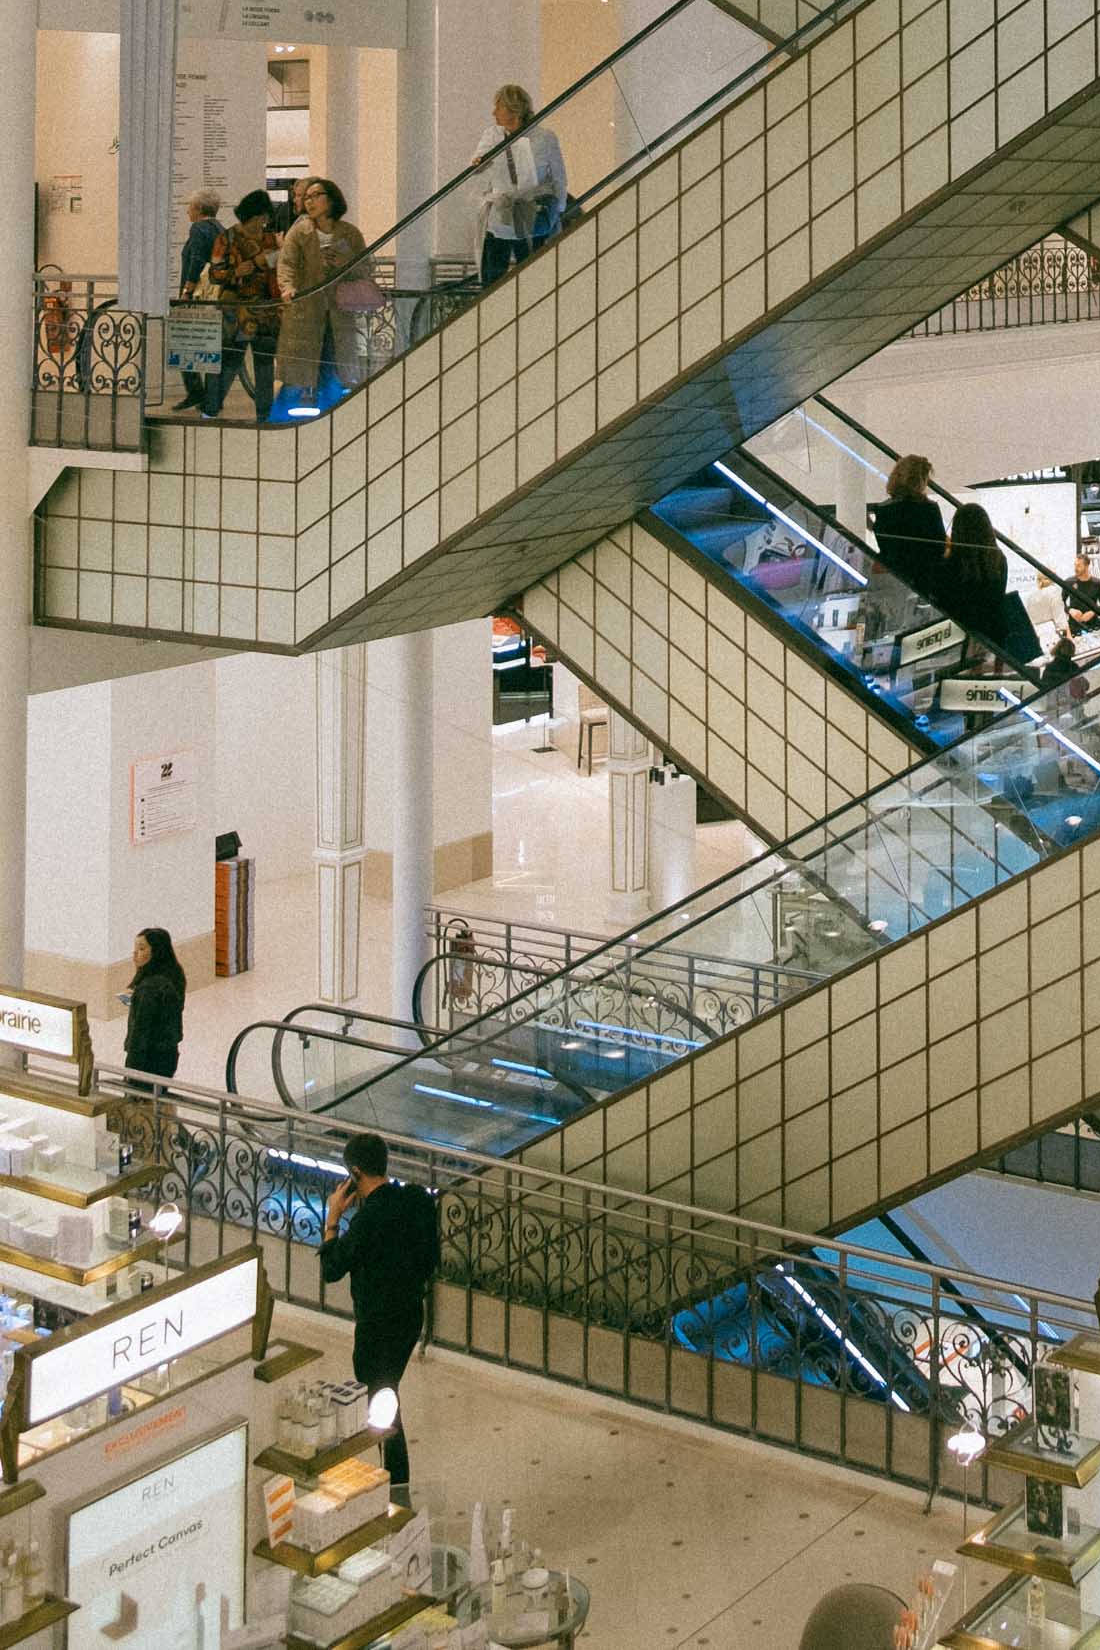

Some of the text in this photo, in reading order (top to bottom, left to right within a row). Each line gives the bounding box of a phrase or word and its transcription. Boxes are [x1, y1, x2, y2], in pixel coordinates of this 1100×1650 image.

[0, 1007, 41, 1034] rairie
[113, 1310, 183, 1369] REN
[142, 1474, 176, 1502] REN
[109, 1520, 203, 1577] Perfect Canvas
